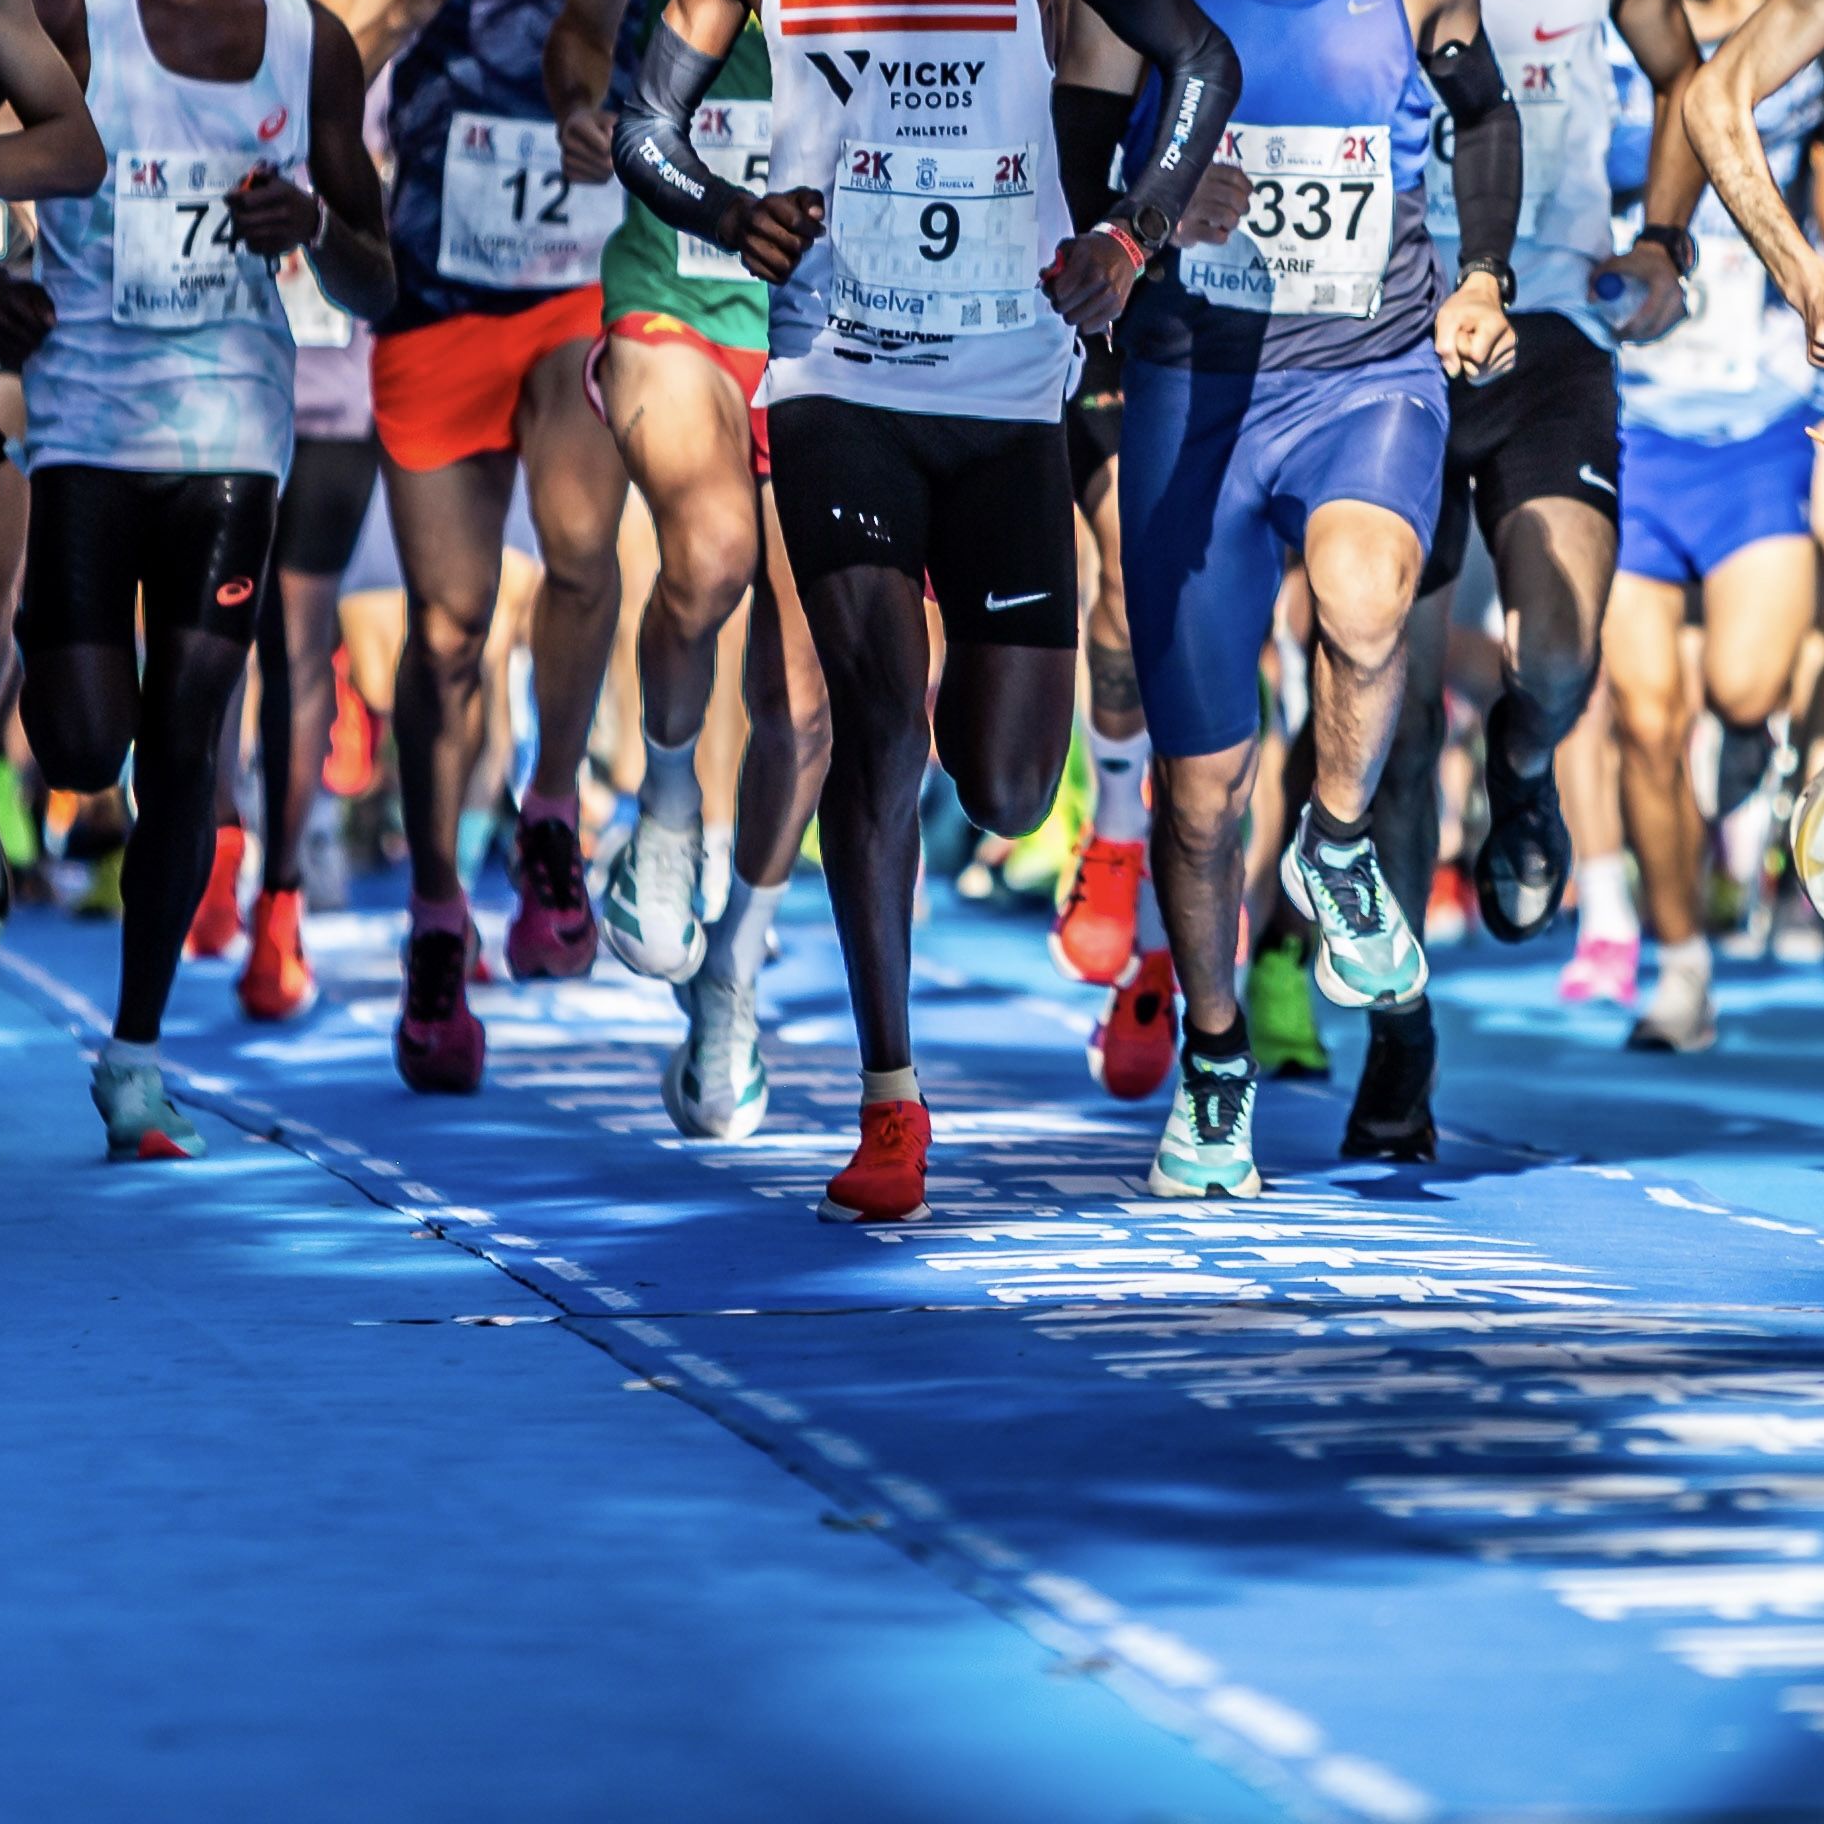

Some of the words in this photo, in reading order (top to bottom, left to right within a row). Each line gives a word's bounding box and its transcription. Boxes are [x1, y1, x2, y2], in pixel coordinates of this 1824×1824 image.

[878, 60, 986, 88] VICKY
[890, 90, 973, 110] FOODS
[895, 124, 968, 137] ATHLETICS
[501, 166, 571, 224] 12
[850, 175, 893, 191] HUELVA
[938, 180, 975, 189] HUELVA
[175, 200, 238, 258] 74
[919, 201, 961, 262] 9
[1190, 262, 1276, 294] Huelva
[1248, 256, 1316, 274] AZARIF
[841, 279, 927, 315] Huelva
